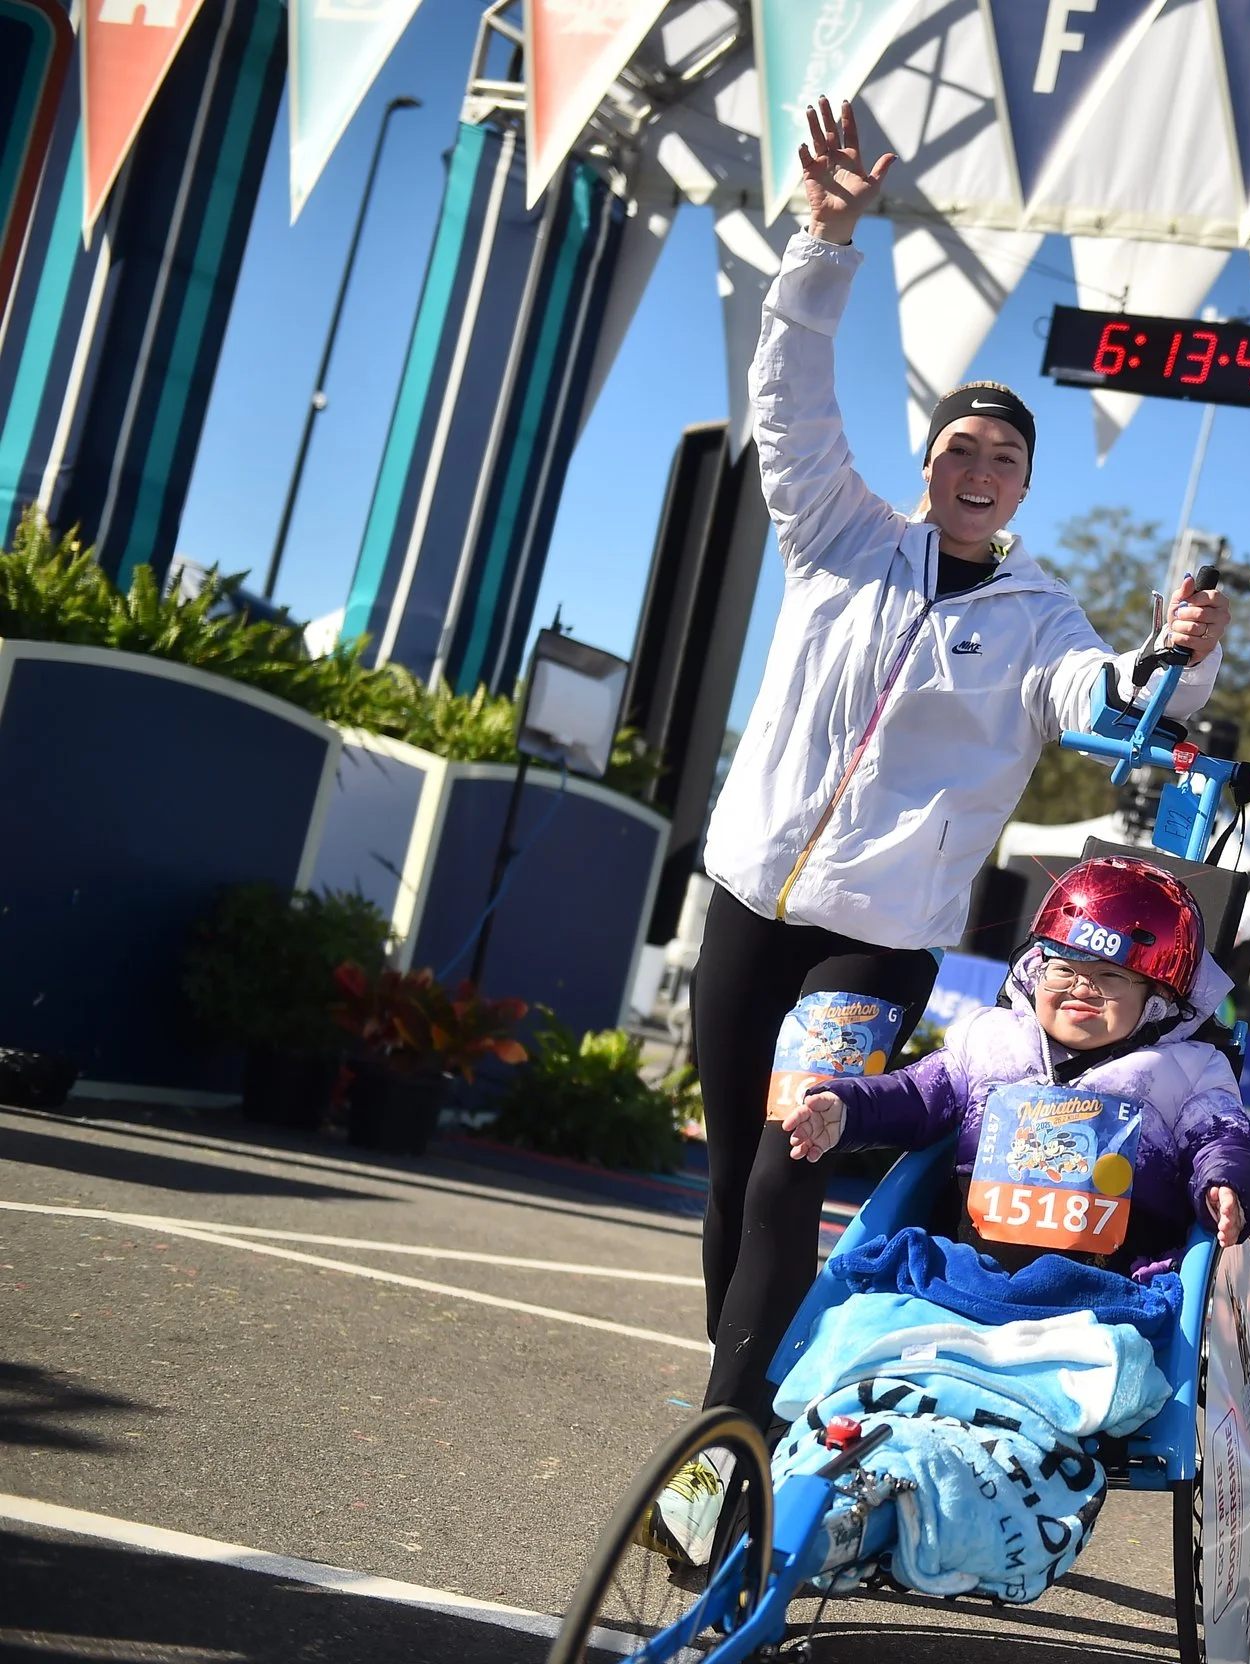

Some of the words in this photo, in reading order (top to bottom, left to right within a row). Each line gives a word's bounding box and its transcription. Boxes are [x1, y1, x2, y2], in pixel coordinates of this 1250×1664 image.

[958, 640, 983, 653] NIKE
[1074, 922, 1122, 957] 269
[888, 1007, 898, 1023] G
[1017, 1097, 1103, 1127] Marathon
[1118, 1101, 1131, 1121] E
[981, 1112, 1001, 1165] 15187
[983, 1186, 1119, 1236] 15187
[1216, 1460, 1226, 1522] MINE
[1225, 1421, 1237, 1598] BOOMERSHINE
[1217, 1530, 1226, 1576] GOT
